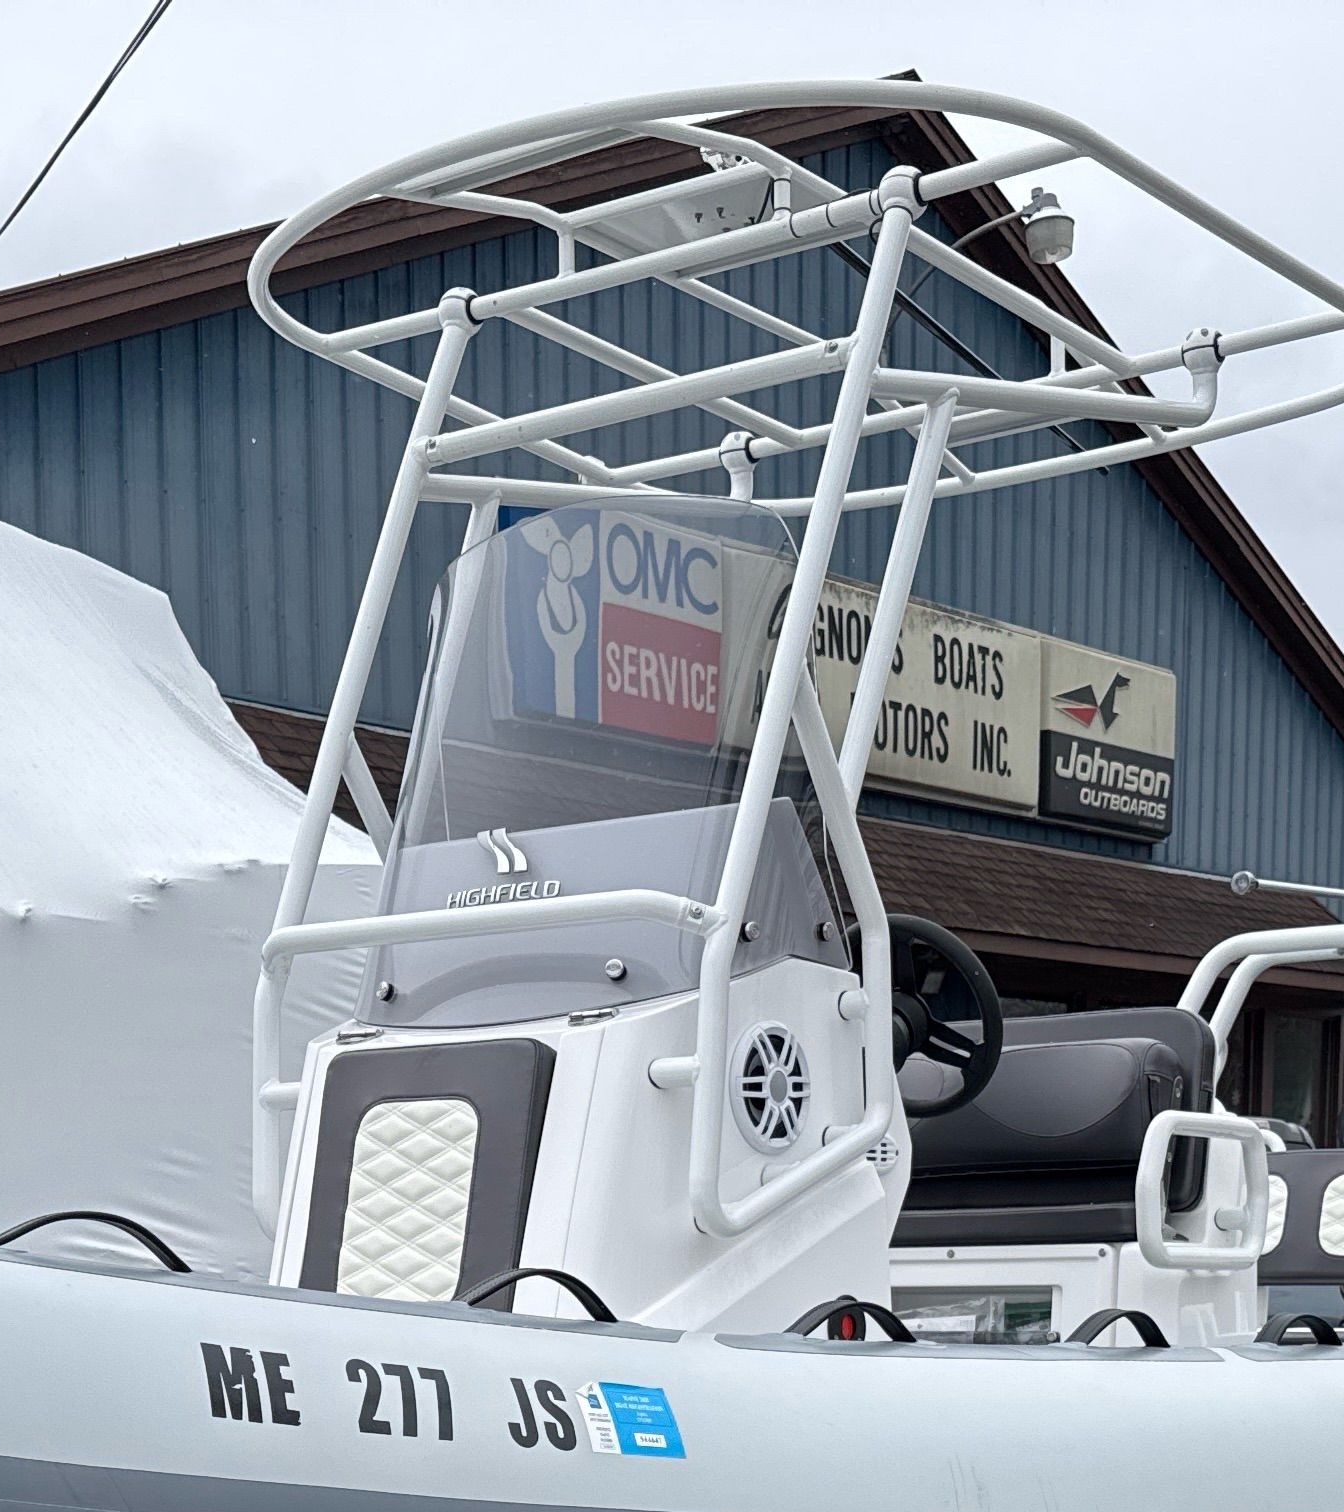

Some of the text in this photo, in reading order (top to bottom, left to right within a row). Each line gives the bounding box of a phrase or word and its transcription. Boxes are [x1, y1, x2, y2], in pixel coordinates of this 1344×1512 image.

[606, 522, 720, 615] OMC
[605, 641, 718, 714] SERVICE
[933, 633, 1004, 701] BOATS
[851, 691, 950, 764] OTORS
[972, 720, 1012, 778] INC.
[1055, 741, 1171, 799] Johnson
[1079, 787, 1167, 820] OUTBOARDS
[446, 880, 561, 909] HIGHFIELD
[200, 1342, 302, 1427] ME
[345, 1358, 455, 1442] 277
[507, 1377, 578, 1452] JS
